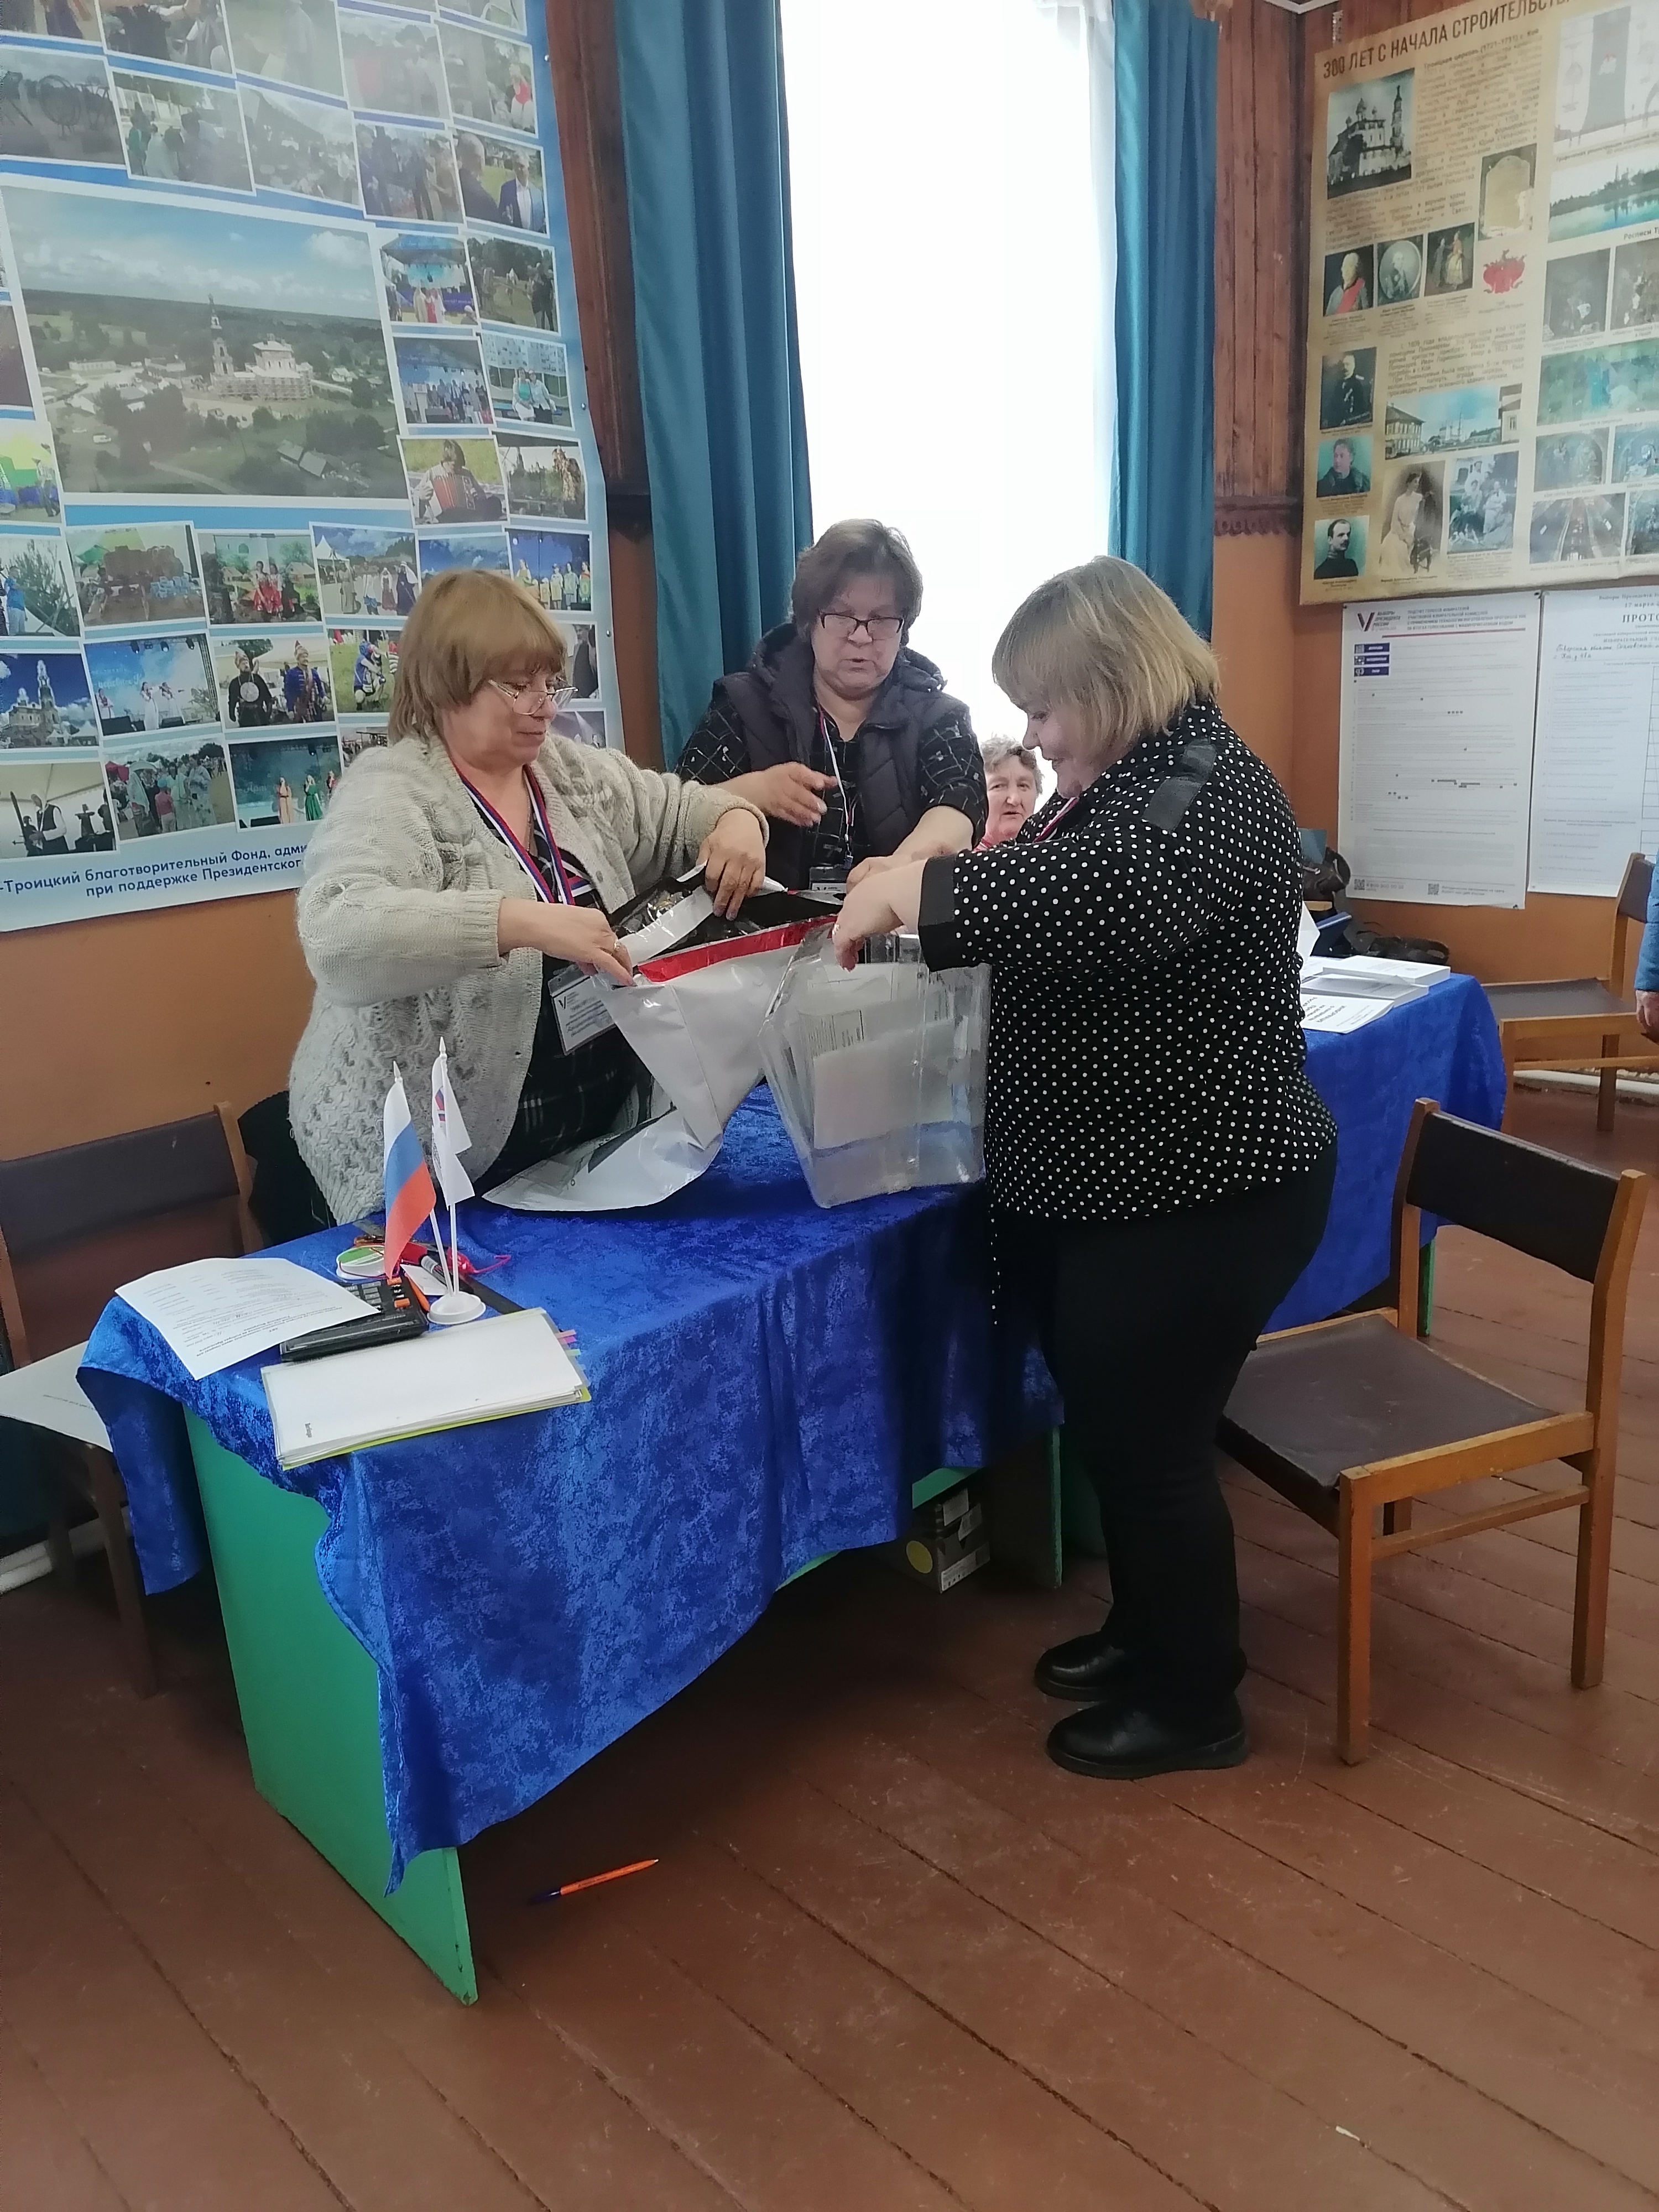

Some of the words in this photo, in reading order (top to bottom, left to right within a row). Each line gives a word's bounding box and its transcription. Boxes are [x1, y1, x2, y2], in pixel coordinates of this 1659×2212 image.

[1323, 56, 1344, 79] 300
[1349, 47, 1374, 70] ЛЕТ
[1378, 43, 1386, 62] С
[1391, 24, 1448, 58] НАЧАЛА
[85, 852, 228, 881] благотворительный
[231, 850, 271, 862] Фонд,
[86, 885, 113, 898] при
[118, 873, 198, 892] поддержке
[202, 859, 304, 881] Президентског
